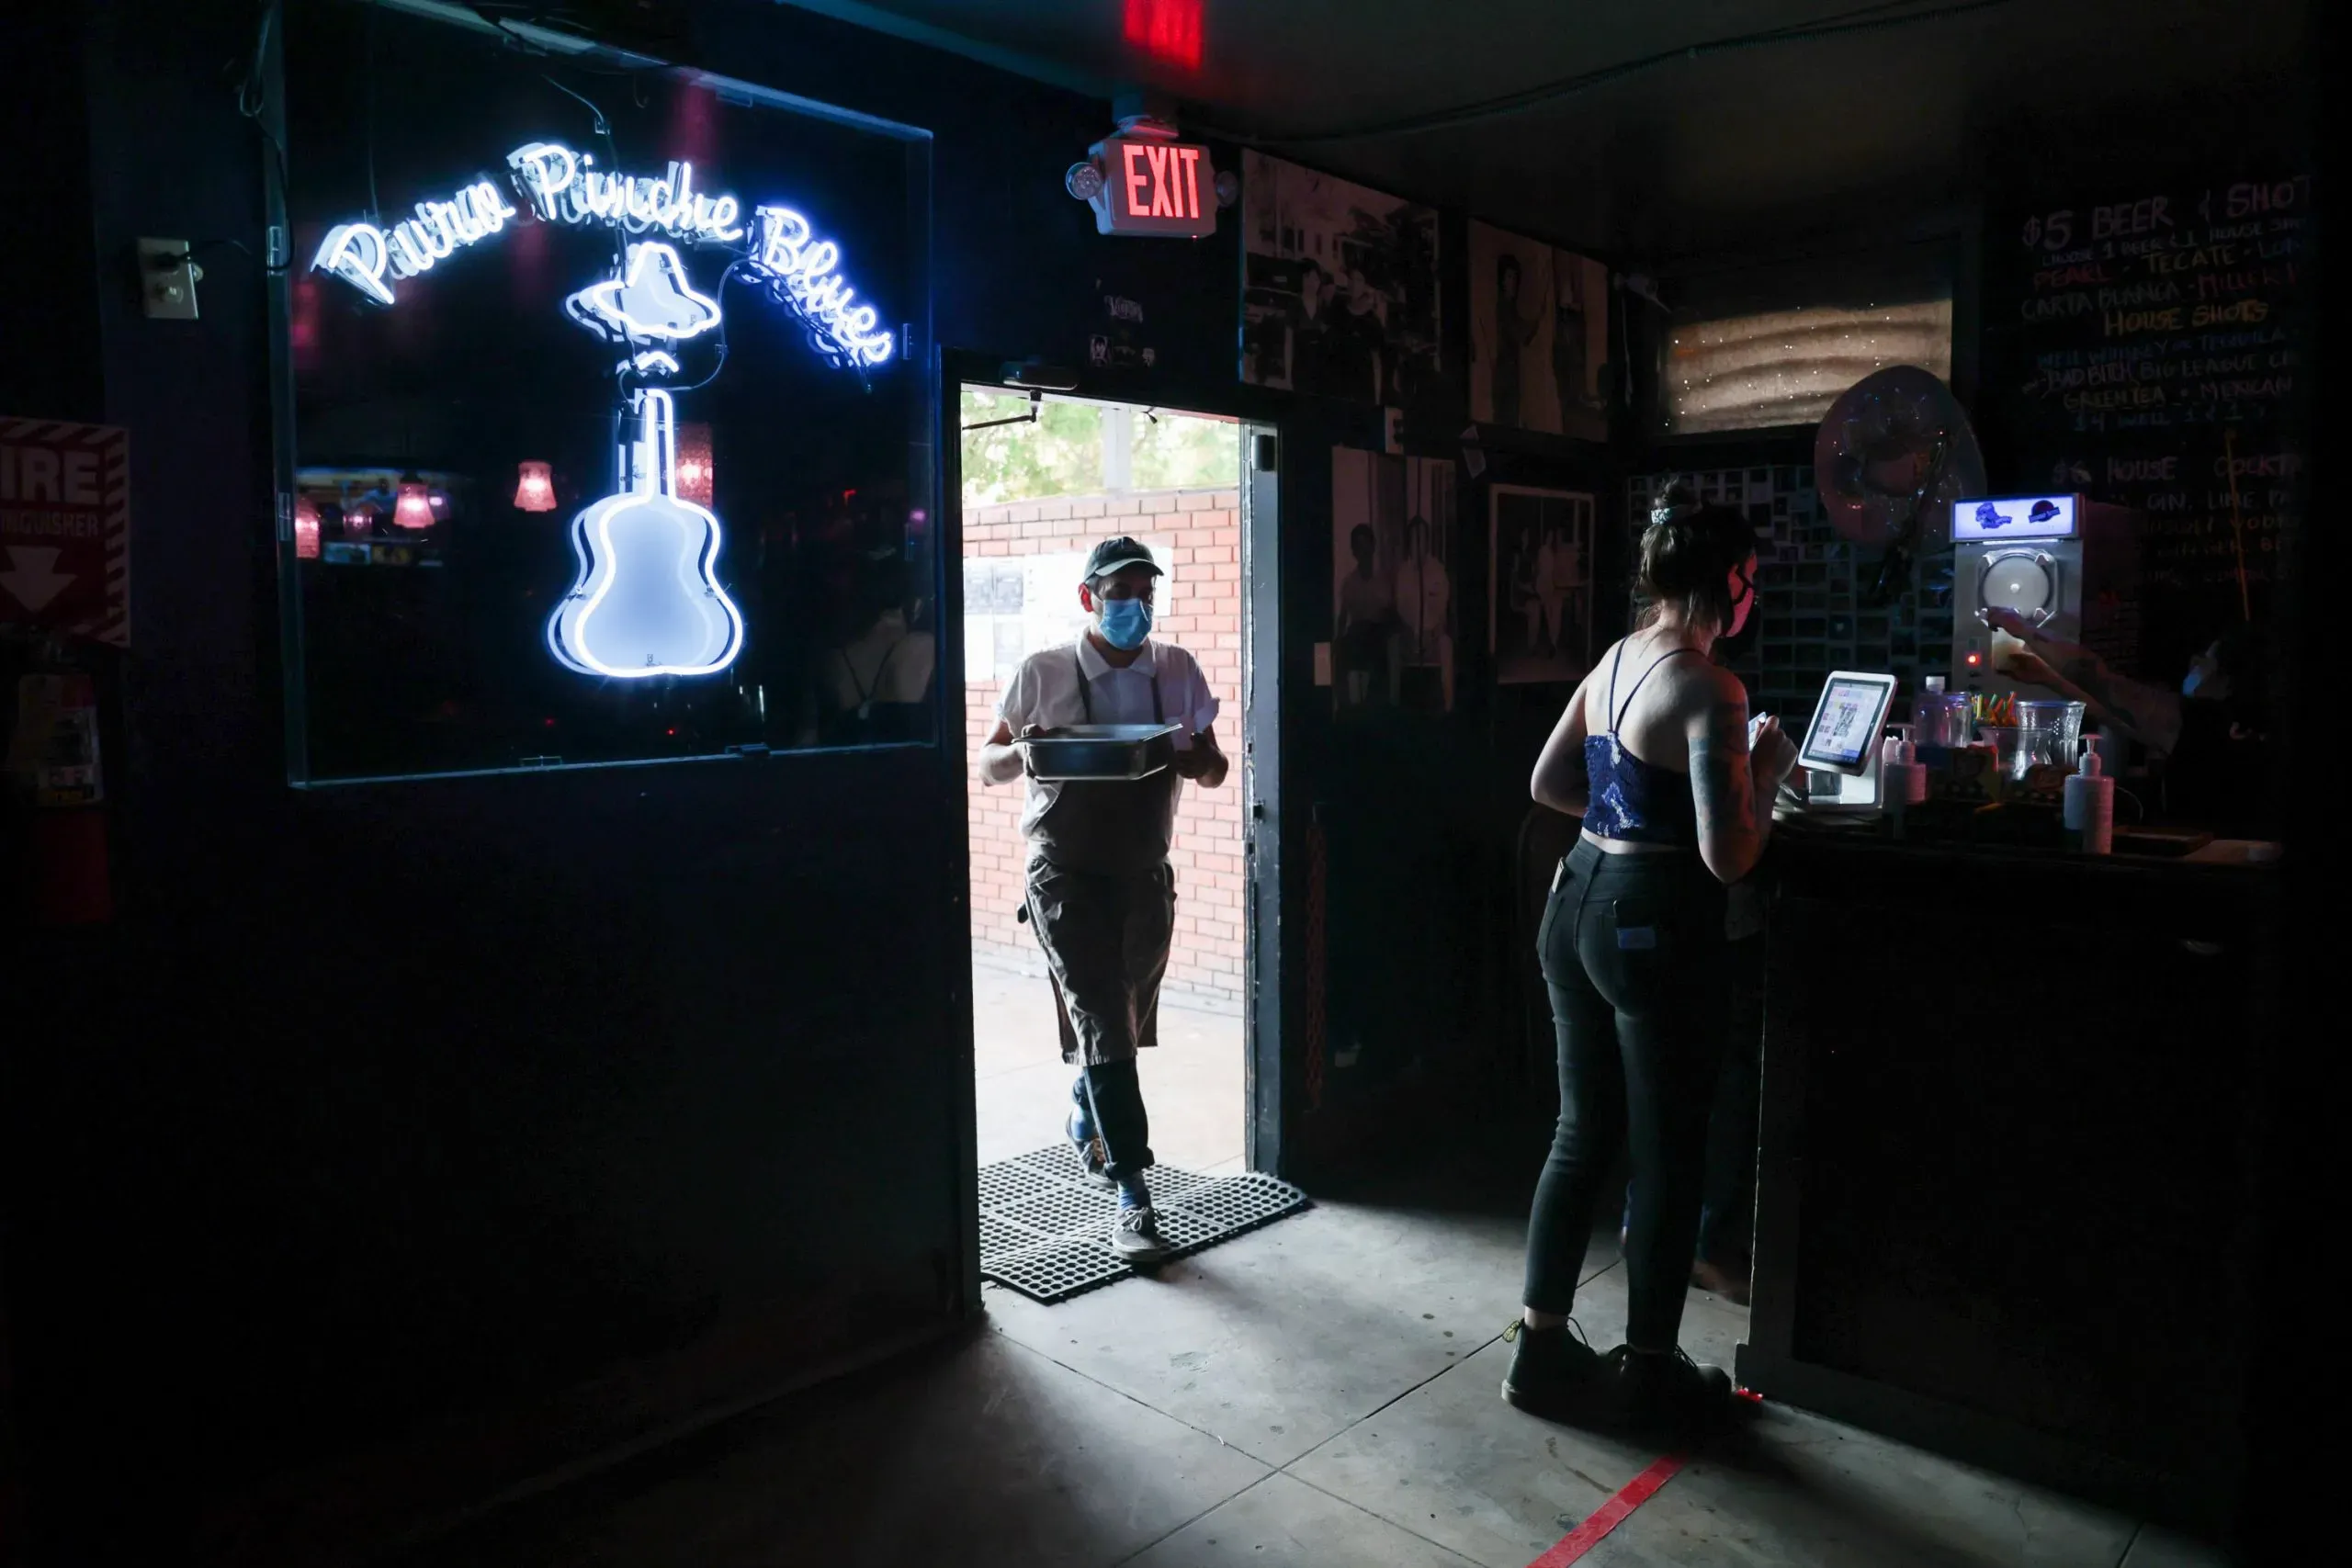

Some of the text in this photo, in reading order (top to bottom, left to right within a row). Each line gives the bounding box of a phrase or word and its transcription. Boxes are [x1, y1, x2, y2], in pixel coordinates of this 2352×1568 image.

[1123, 144, 1200, 220] EXIT
[2021, 209, 2075, 252] $5
[2092, 195, 2176, 241] BEER
[2121, 238, 2165, 256] BEER
[2209, 220, 2265, 243] HOUSE
[511, 143, 743, 241] Pinche
[758, 205, 892, 364] Blues
[2033, 263, 2113, 291] PEARL
[2140, 243, 2237, 274] TECATE
[2020, 291, 2094, 323] CARTA
[2098, 280, 2180, 311] BLANCA
[2103, 299, 2269, 337] HOUSE SHOTS
[2140, 360, 2177, 382] BIG
[0, 445, 100, 504] IRE
[2107, 455, 2179, 484] HOUSE
[2212, 454, 2302, 479] COCKT
[0, 508, 99, 538] INGUISHER
